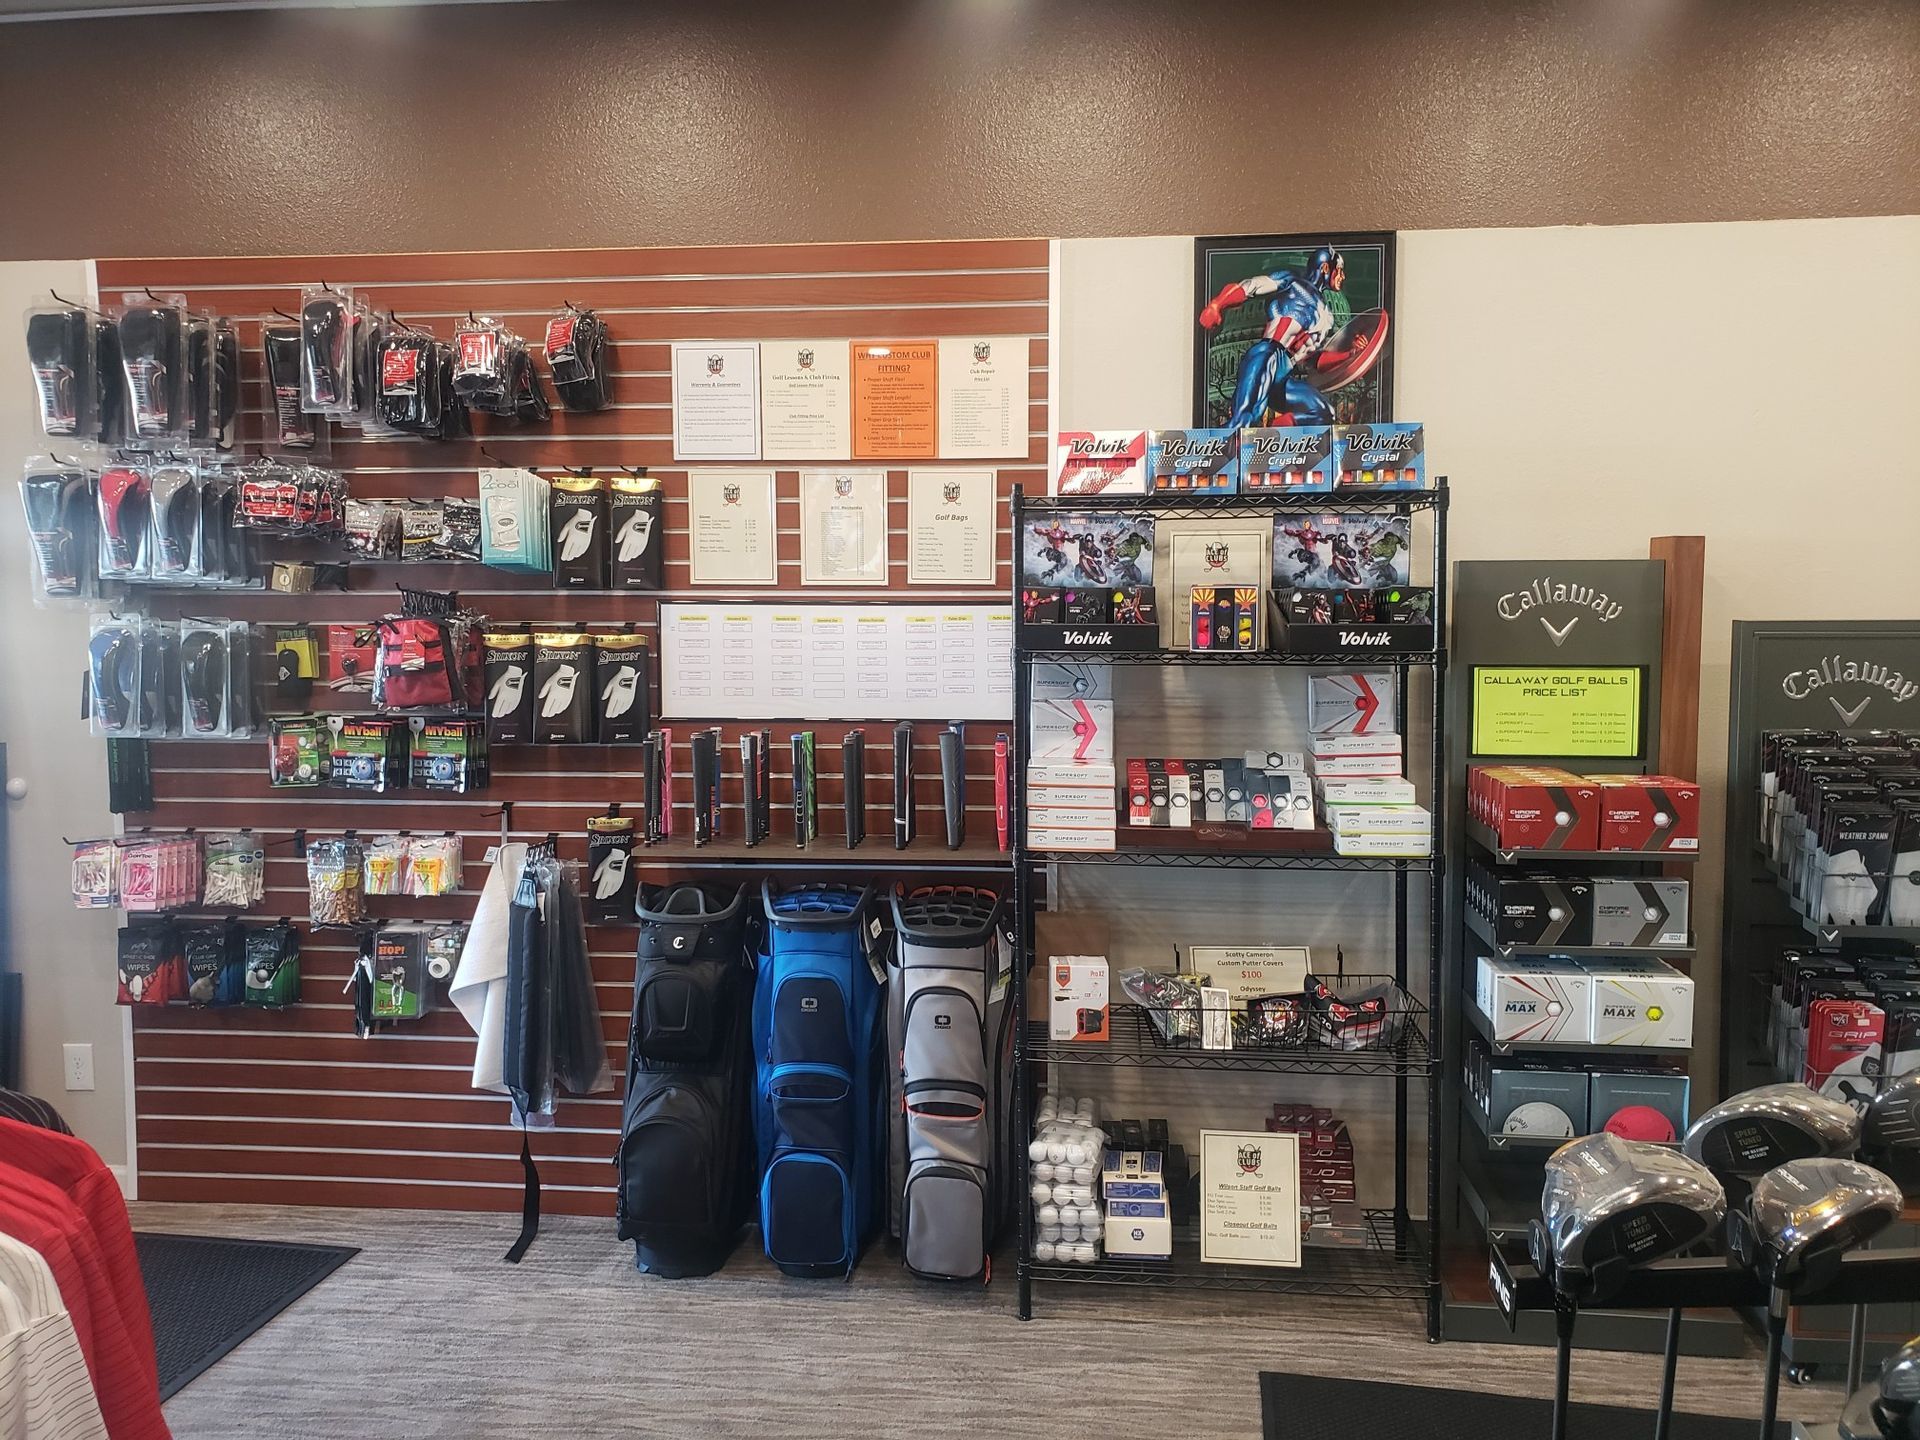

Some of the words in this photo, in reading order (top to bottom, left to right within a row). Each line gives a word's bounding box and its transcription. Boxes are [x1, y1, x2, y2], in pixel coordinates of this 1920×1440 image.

[878, 364, 911, 373] FITTING?
[1070, 438, 1129, 455] Volvik
[1160, 438, 1225, 456] Volvik
[1254, 436, 1320, 455] Volvik
[1346, 433, 1413, 451] Volvik
[1174, 458, 1212, 470] Crystal
[1268, 456, 1307, 467] Crystal
[1361, 452, 1400, 464] Crystal
[1498, 576, 1623, 622] Callaway
[1063, 632, 1112, 645] Volvik
[1339, 632, 1392, 646] Volvik
[1484, 676, 1548, 684] CALLAWAY
[1552, 676, 1584, 684] GOLF
[1588, 676, 1628, 685] BALLS
[1782, 654, 1918, 702] Callaway
[344, 725, 382, 736] MYball
[425, 726, 462, 736] MYball
[1840, 832, 1866, 840] WEATHER
[192, 964, 217, 972] WIPES
[1505, 1004, 1536, 1012] MAX
[1603, 1008, 1636, 1017] MAX
[1734, 1128, 1757, 1139] SPEED
[1739, 1135, 1761, 1146] TUNED
[1580, 1151, 1609, 1175] ROGUE
[1622, 1216, 1647, 1231] SPEED
[1626, 1224, 1652, 1239] TUNED
[1490, 1262, 1510, 1312] PING
